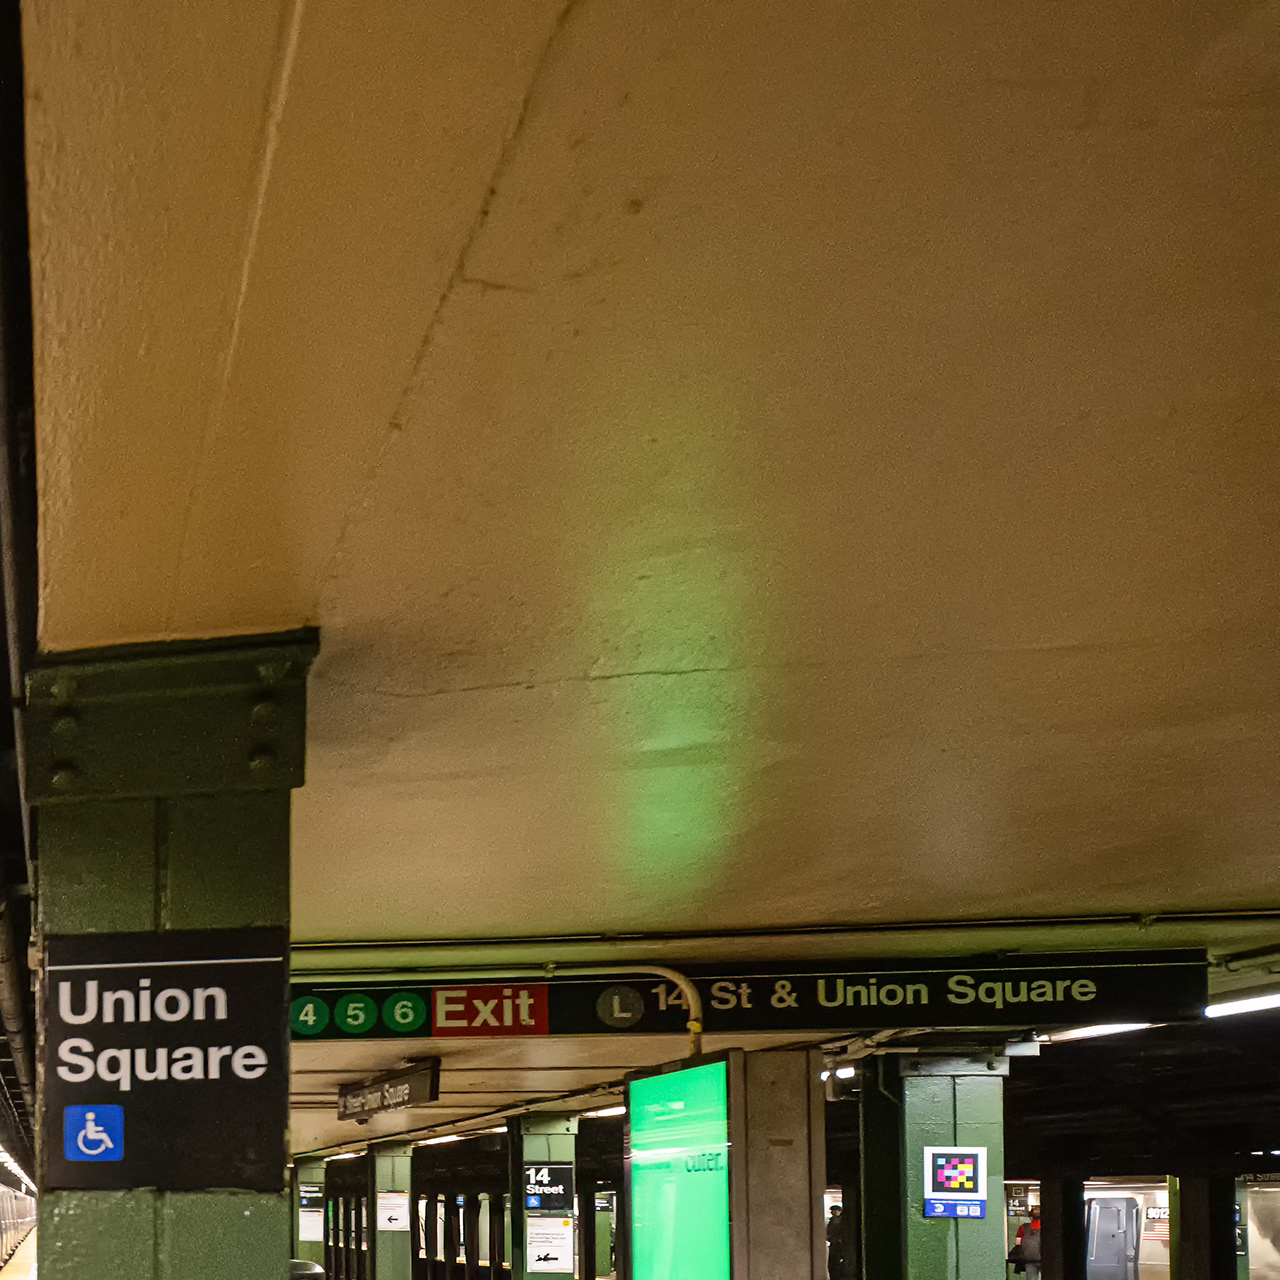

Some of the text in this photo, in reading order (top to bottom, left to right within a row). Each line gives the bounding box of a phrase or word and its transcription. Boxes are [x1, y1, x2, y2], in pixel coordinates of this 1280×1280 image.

[56, 978, 228, 1025] Union
[298, 1003, 317, 1026] 4
[346, 1003, 366, 1025] 5
[393, 1001, 414, 1024] 6
[436, 988, 535, 1027] Exit
[612, 995, 633, 1018] L
[710, 981, 753, 1010] St
[771, 980, 799, 1008] &
[816, 978, 930, 1008] Union
[946, 975, 1097, 1010] Square
[55, 1037, 268, 1091] Square
[525, 1167, 551, 1184] 14
[526, 1184, 564, 1195] Street
